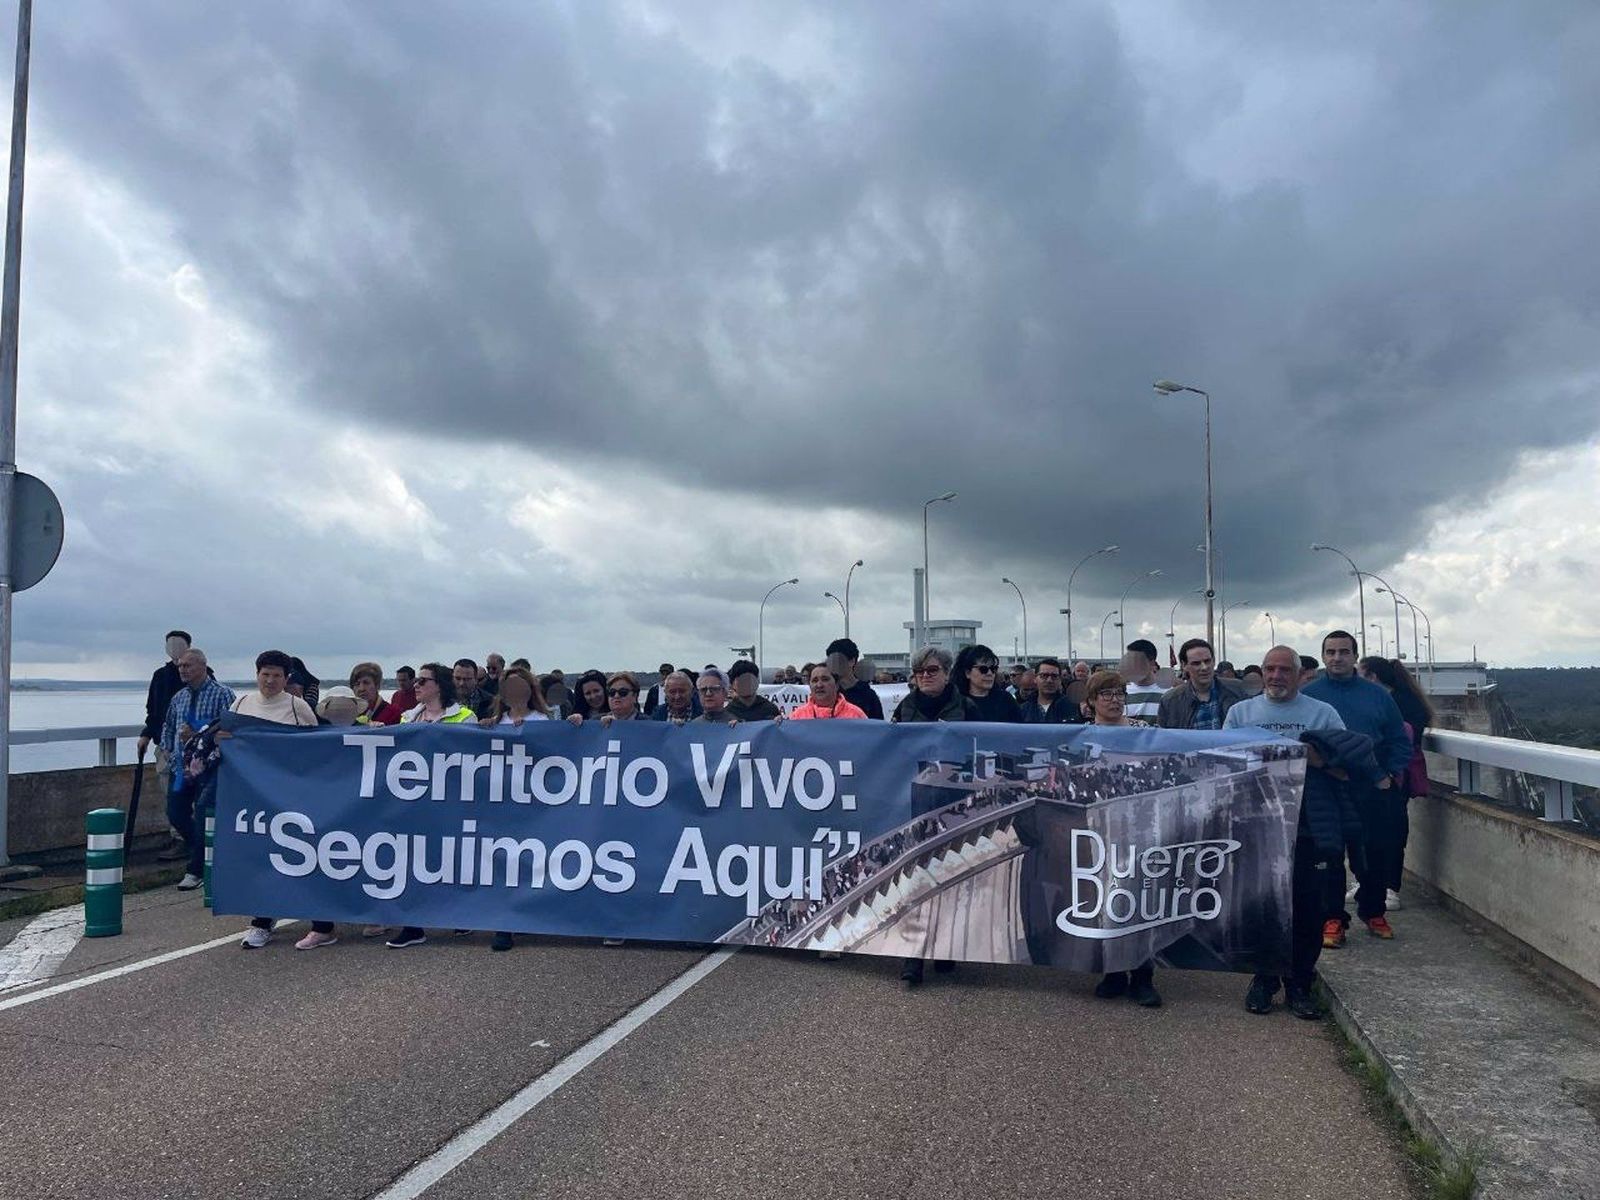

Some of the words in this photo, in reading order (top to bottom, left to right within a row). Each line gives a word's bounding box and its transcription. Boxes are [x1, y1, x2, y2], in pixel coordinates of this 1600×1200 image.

[342, 734, 669, 808] Territorio
[690, 741, 857, 811] Vivo:
[234, 808, 636, 900] “Seguimos
[659, 828, 862, 917] Aquí”
[1070, 829, 1225, 878] Duero
[1072, 873, 1222, 923] Douro
